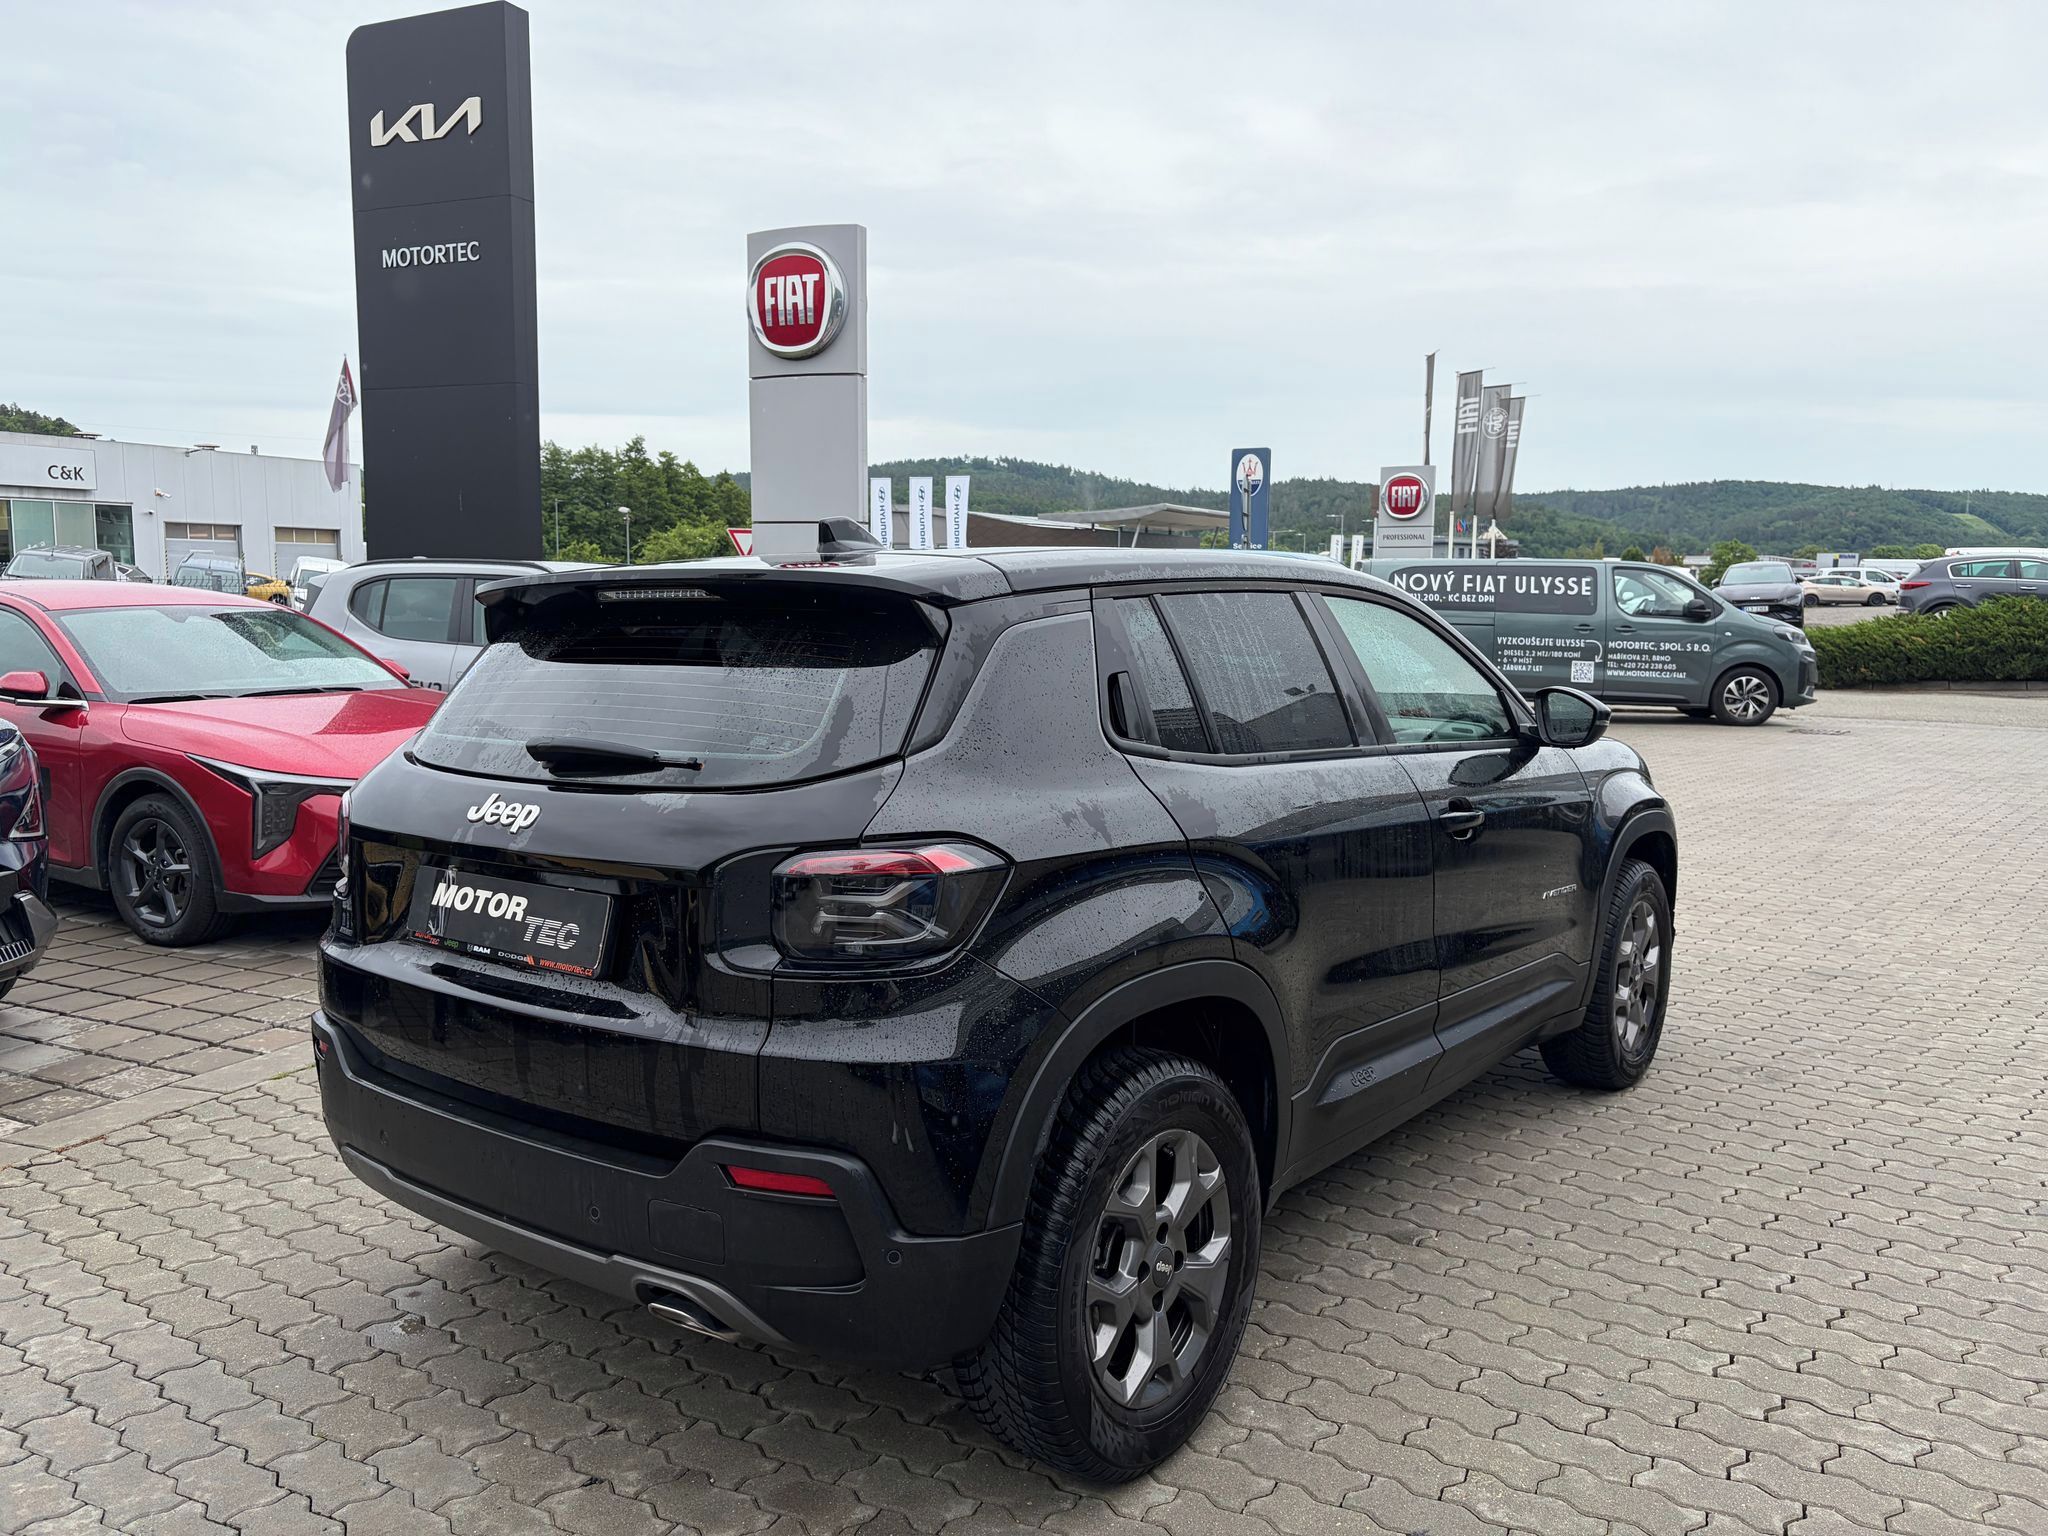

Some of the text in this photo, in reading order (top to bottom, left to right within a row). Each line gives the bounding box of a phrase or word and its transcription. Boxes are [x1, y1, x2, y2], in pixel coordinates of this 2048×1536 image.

[371, 96, 482, 146] KIA
[382, 241, 480, 268] MOTORTEC
[764, 273, 820, 327] FIAT
[1457, 396, 1480, 434] FIAT
[47, 465, 85, 481] C&K
[1391, 485, 1420, 508] FIAT
[880, 504, 888, 546] HYUNDAI
[1232, 542, 1263, 550] Seice
[1382, 533, 1426, 541] PROFESSIONAL
[1394, 571, 1592, 595] NOVÝ FIAT ULYSSE
[1461, 594, 1476, 603] BEZ
[1478, 595, 1495, 603] DPH
[1497, 636, 1585, 647] VYZKOUŠEJTE ULYSSE
[1608, 641, 1658, 651] MOTORTEC,
[1660, 642, 1685, 651] SPOL.
[1686, 643, 1692, 651] S
[467, 793, 541, 834] Jeep
[431, 882, 529, 922] MOTOR
[523, 915, 580, 950] TEC
[473, 946, 491, 955] RAM
[540, 958, 593, 977] www.motortec.cz
